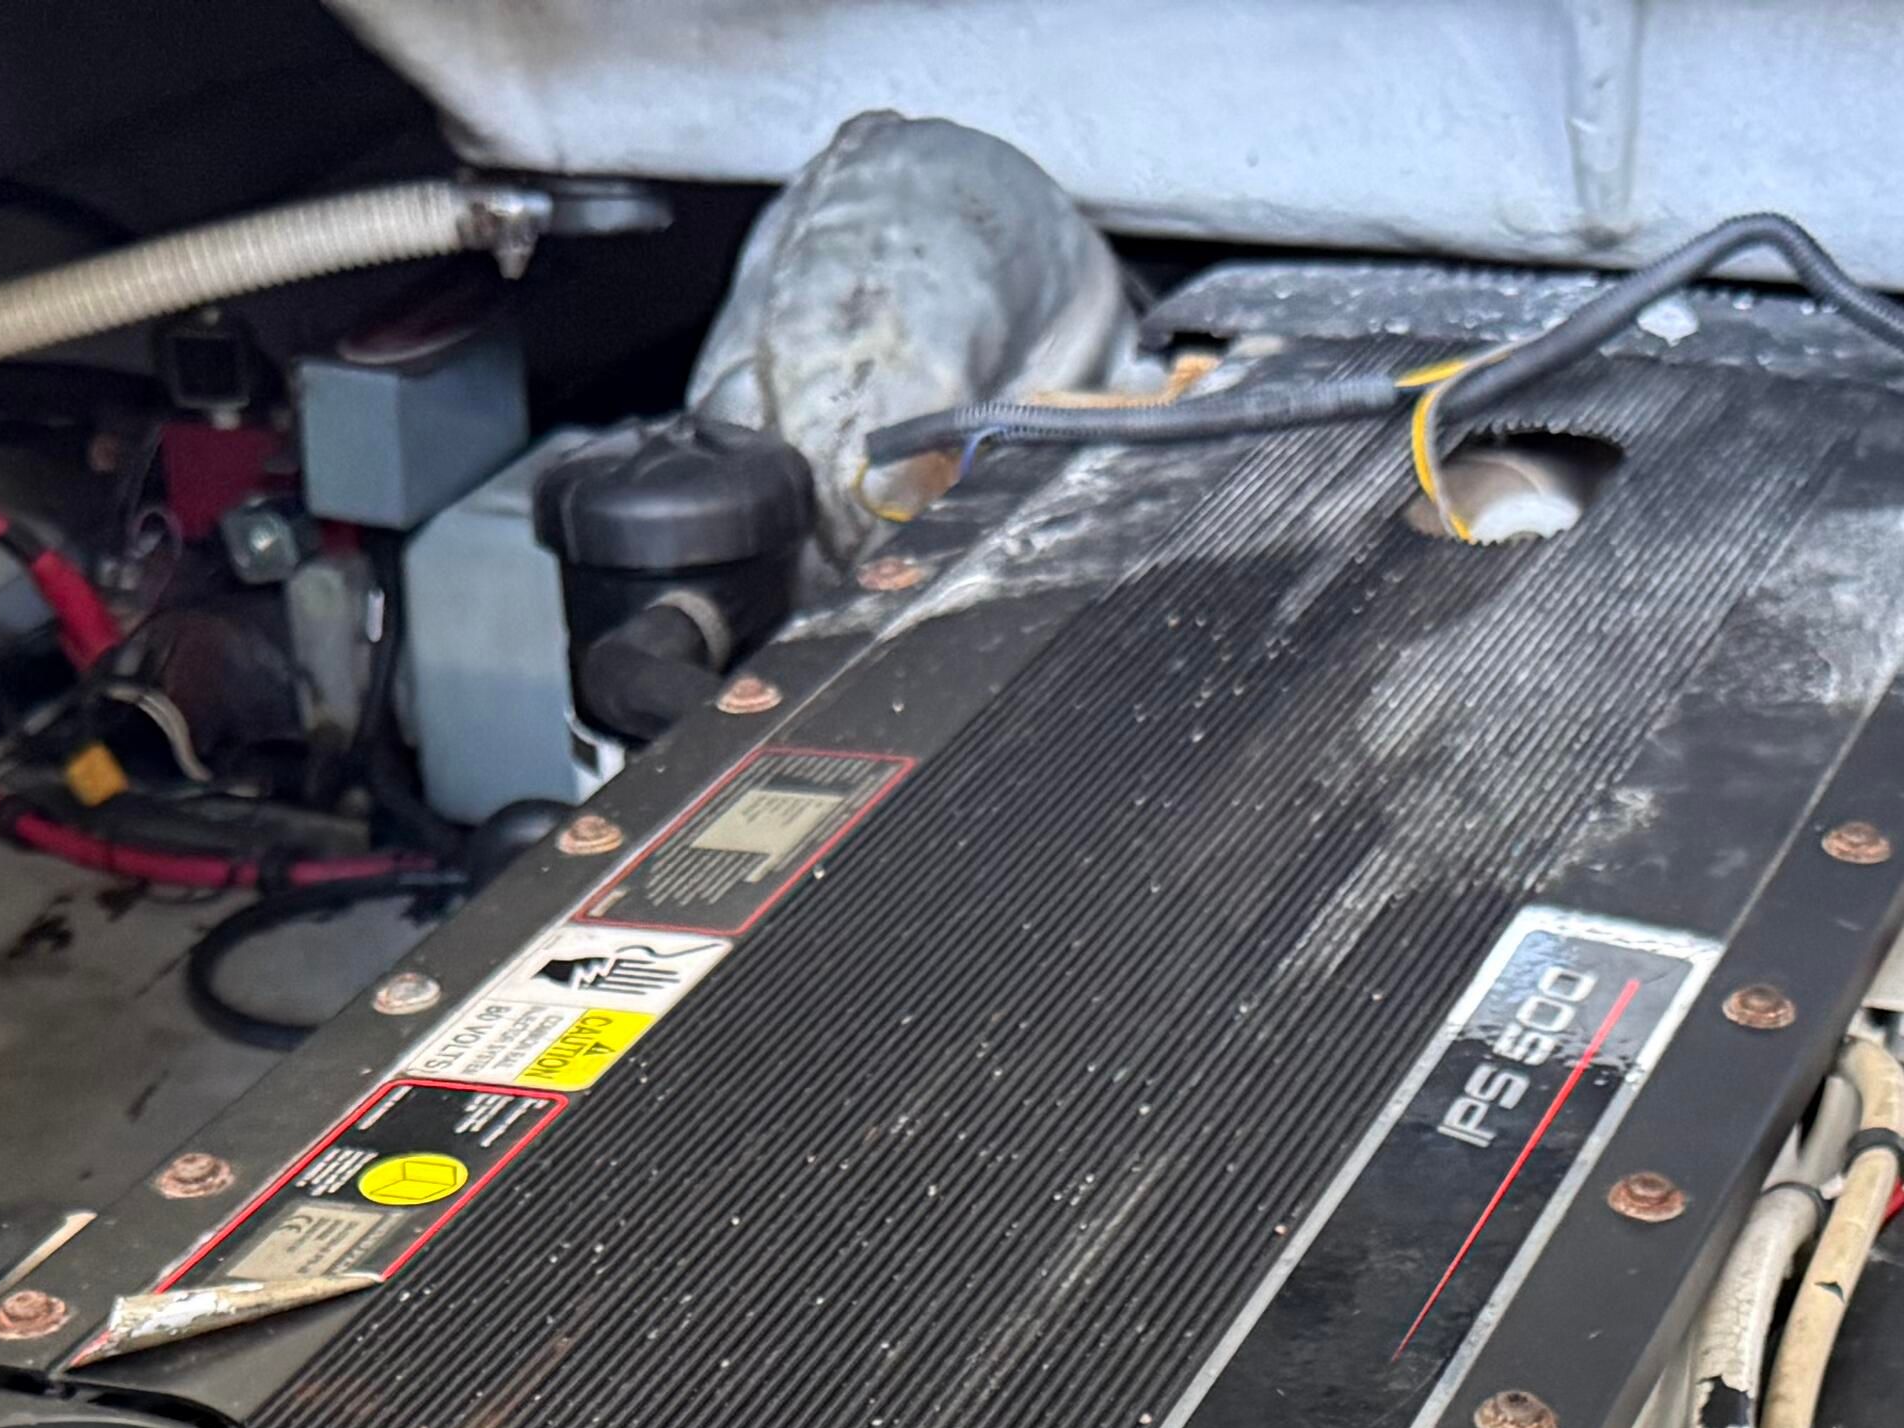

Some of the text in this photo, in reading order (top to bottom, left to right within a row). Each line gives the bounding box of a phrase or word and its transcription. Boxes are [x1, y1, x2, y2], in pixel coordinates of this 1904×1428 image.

[423, 1025, 494, 1070] VOLTS
[523, 1016, 613, 1079] CAUTION
[1437, 964, 1598, 1148] IPS 500
